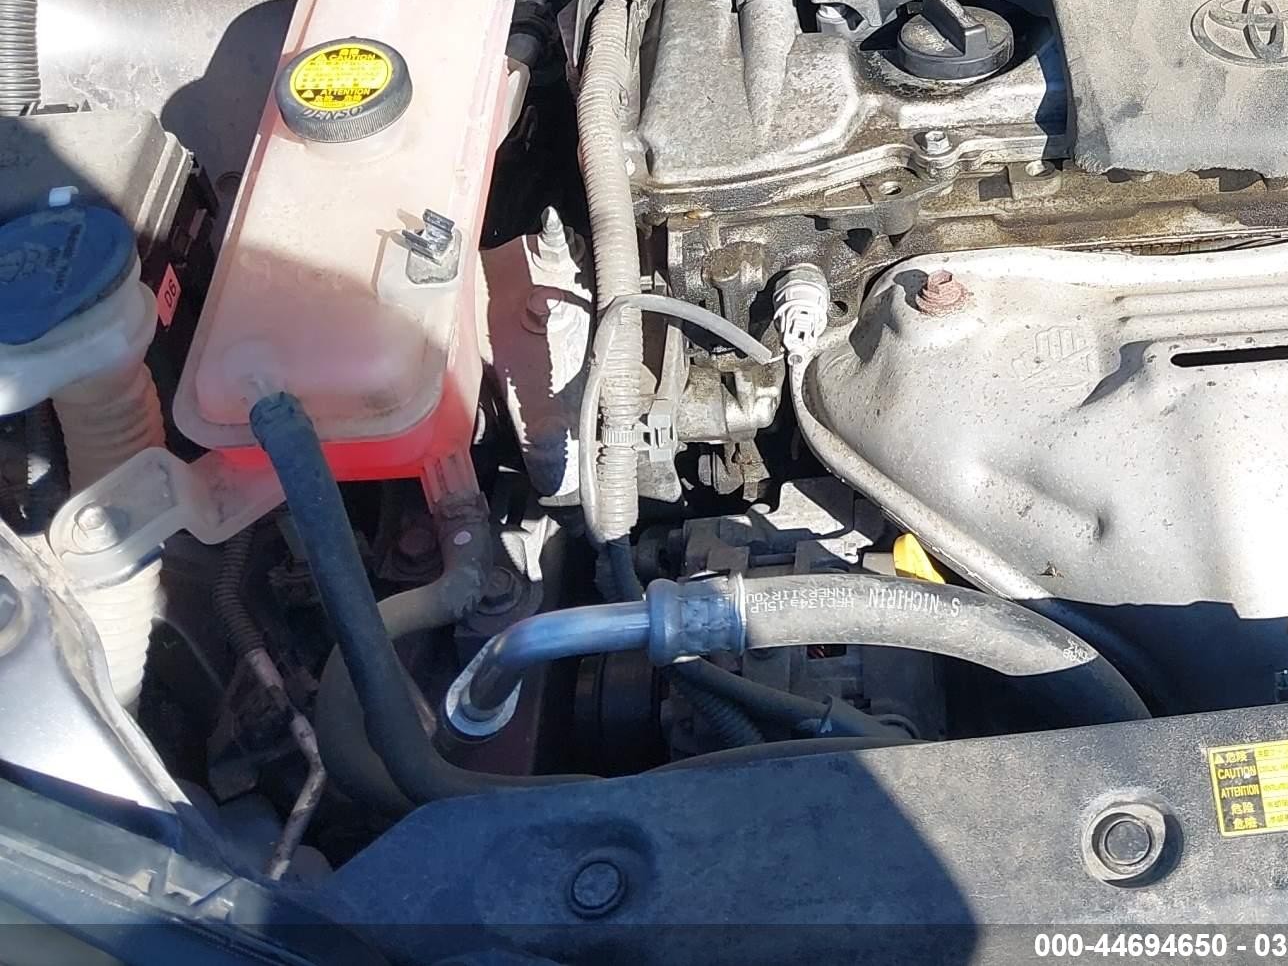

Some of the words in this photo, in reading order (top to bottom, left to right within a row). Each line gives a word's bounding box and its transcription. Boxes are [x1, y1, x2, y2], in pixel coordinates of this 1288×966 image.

[329, 54, 376, 62] CAUTION
[319, 88, 371, 97] ATTENTION
[868, 586, 940, 616] NICHIRIN
[1217, 765, 1257, 780] CAUTION
[1220, 783, 1260, 799] ATTENTION
